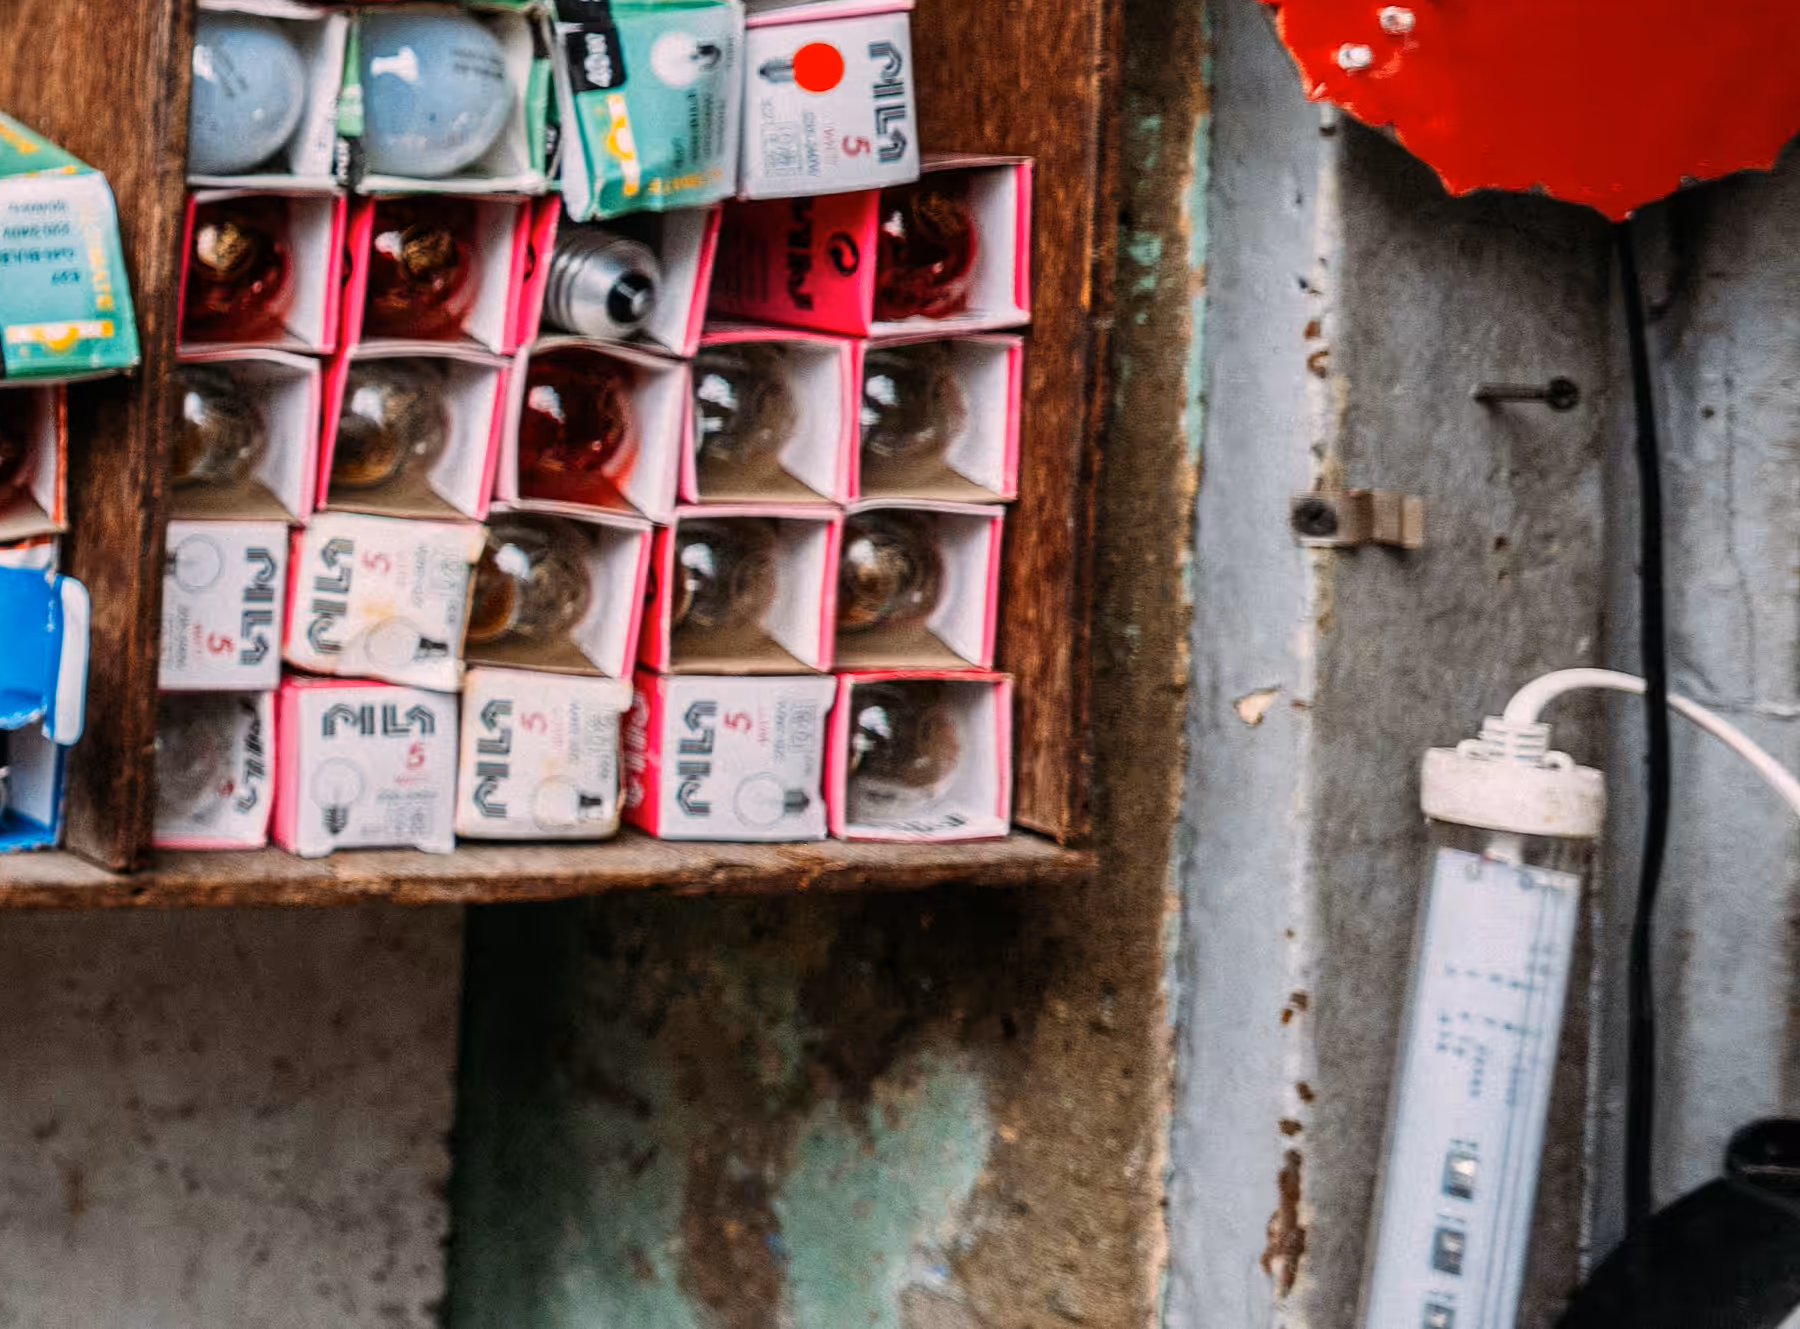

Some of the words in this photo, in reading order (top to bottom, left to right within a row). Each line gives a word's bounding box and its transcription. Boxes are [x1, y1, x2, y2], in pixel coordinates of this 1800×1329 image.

[868, 39, 907, 164] PILA
[842, 135, 872, 157] 5
[362, 551, 391, 575] 5
[239, 546, 278, 667] PILA
[306, 537, 355, 654] PILA
[207, 631, 234, 655] 5
[321, 702, 435, 738] PILA
[520, 711, 548, 734] 5
[724, 711, 752, 734] 5
[405, 739, 426, 770] 5
[473, 698, 513, 819] PILA
[676, 699, 718, 817] PILA
